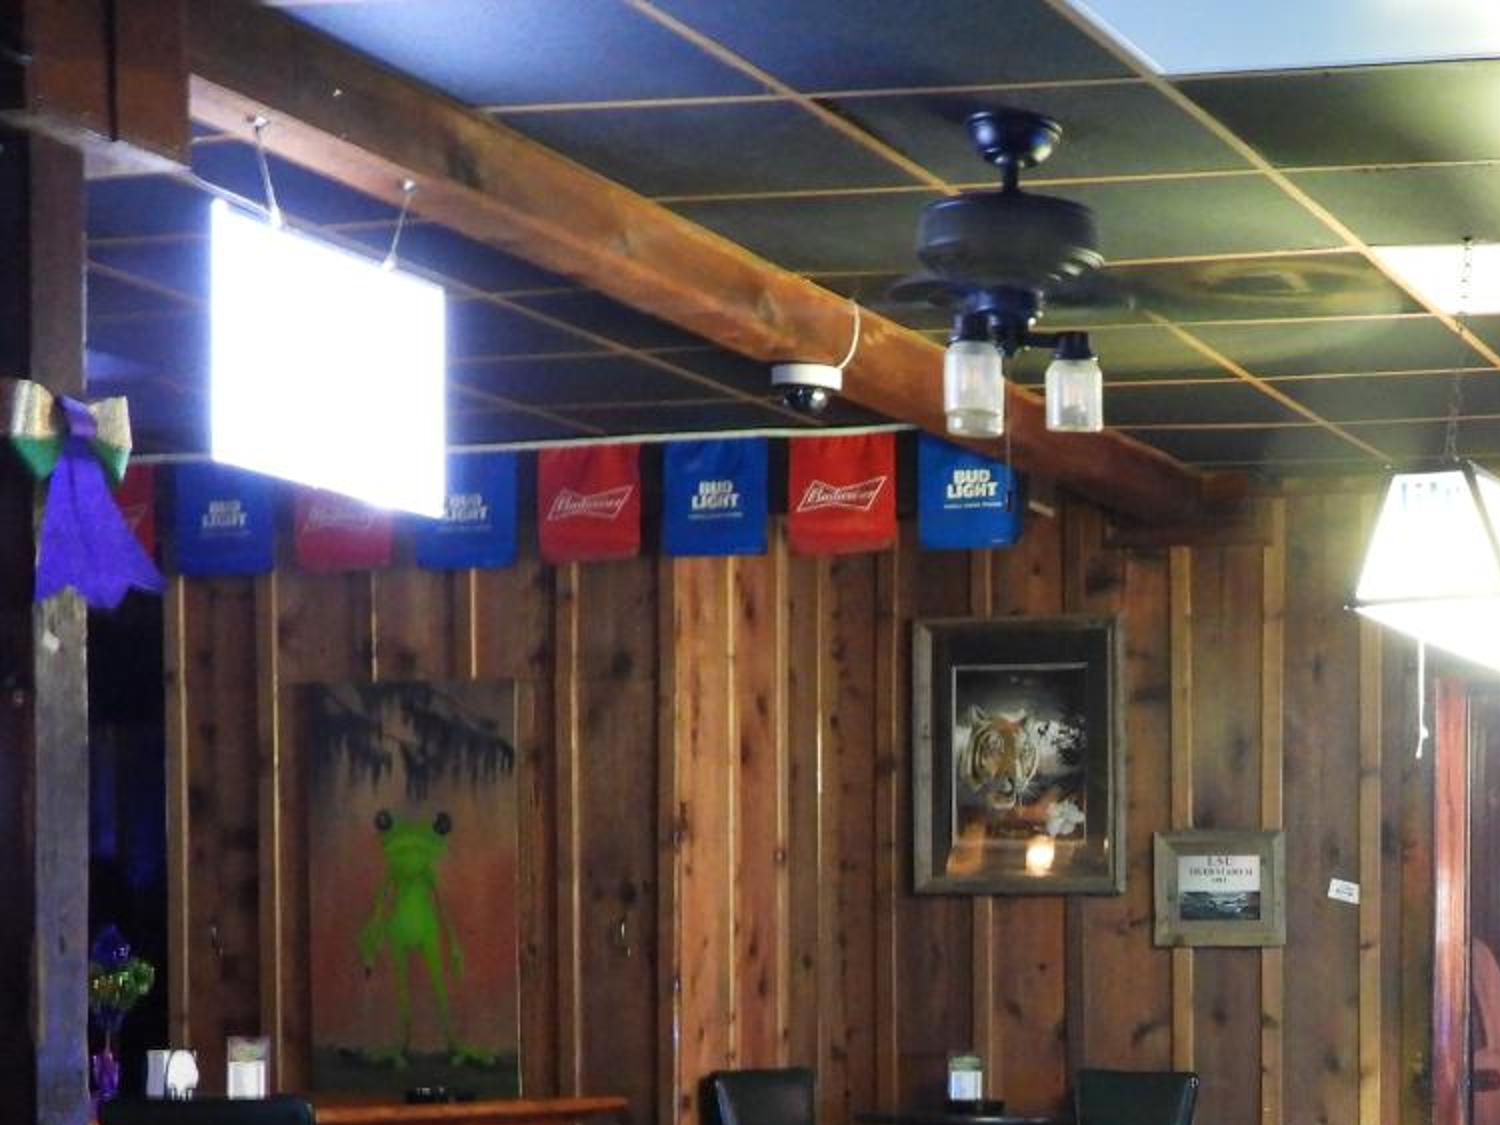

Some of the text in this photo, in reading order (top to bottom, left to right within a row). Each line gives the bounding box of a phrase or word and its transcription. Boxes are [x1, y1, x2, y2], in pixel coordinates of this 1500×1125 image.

[953, 469, 991, 485] BUD
[698, 480, 733, 495] BUD
[946, 481, 999, 499] LIGHT
[691, 493, 740, 511] LIGHT
